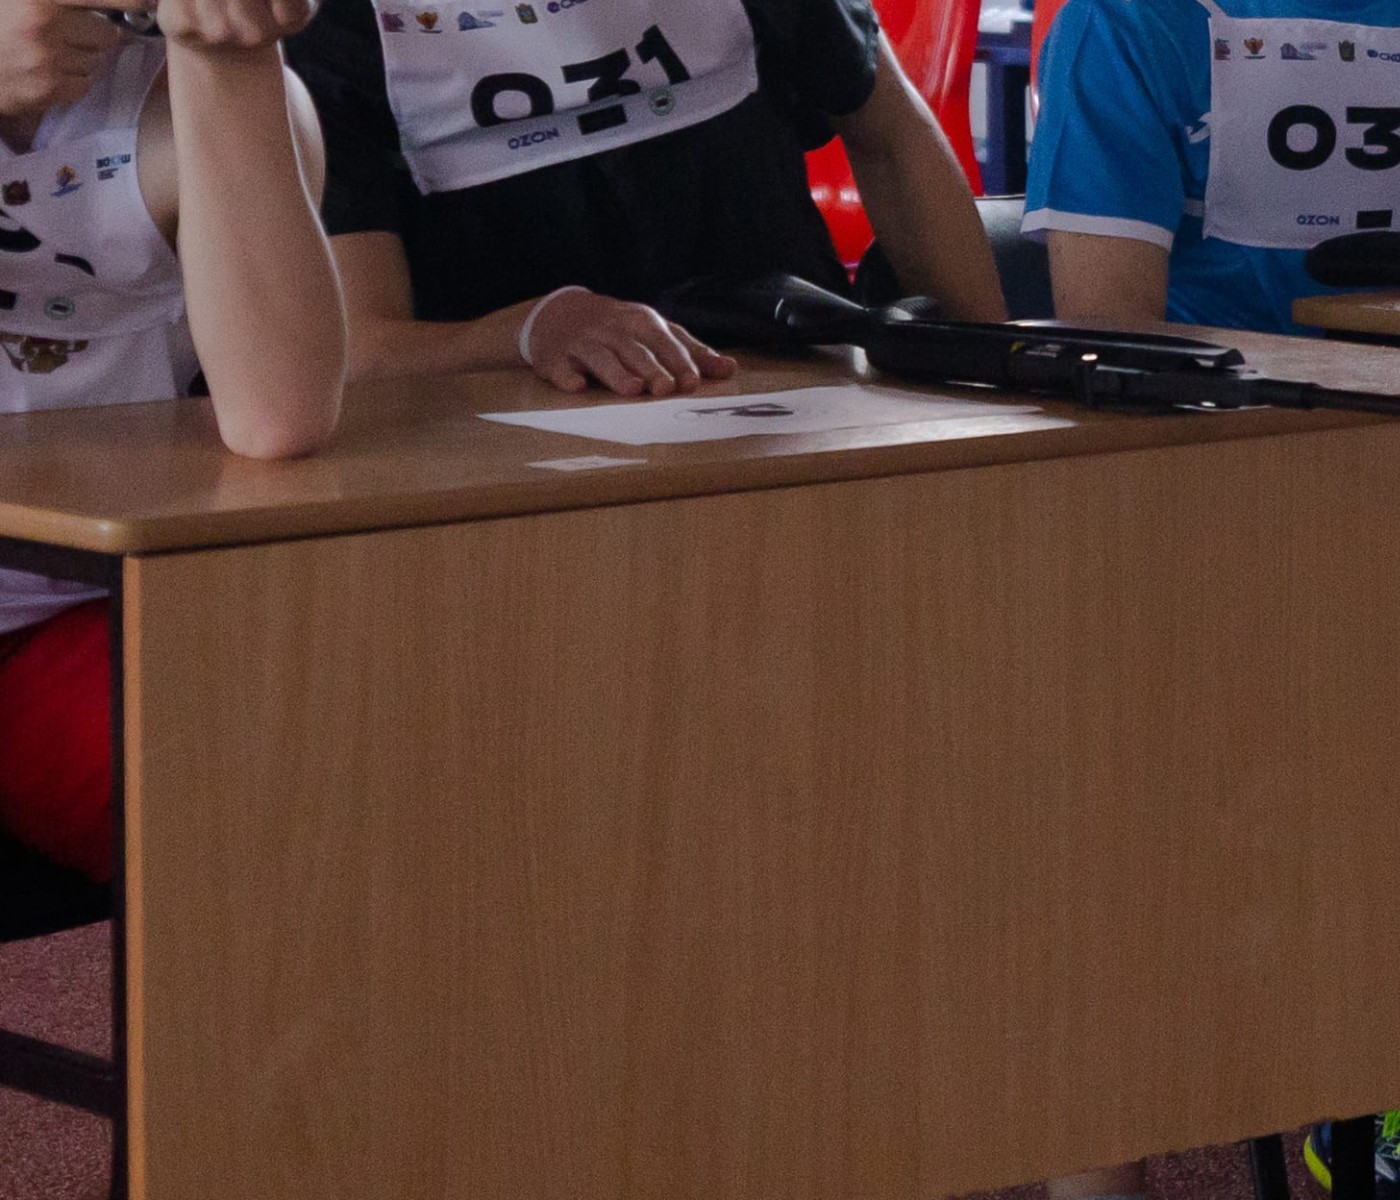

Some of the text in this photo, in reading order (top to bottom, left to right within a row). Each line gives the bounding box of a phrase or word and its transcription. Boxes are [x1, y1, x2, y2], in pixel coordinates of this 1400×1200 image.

[471, 24, 692, 128] 031
[508, 126, 560, 150] OZON
[1296, 214, 1341, 227] OZON
